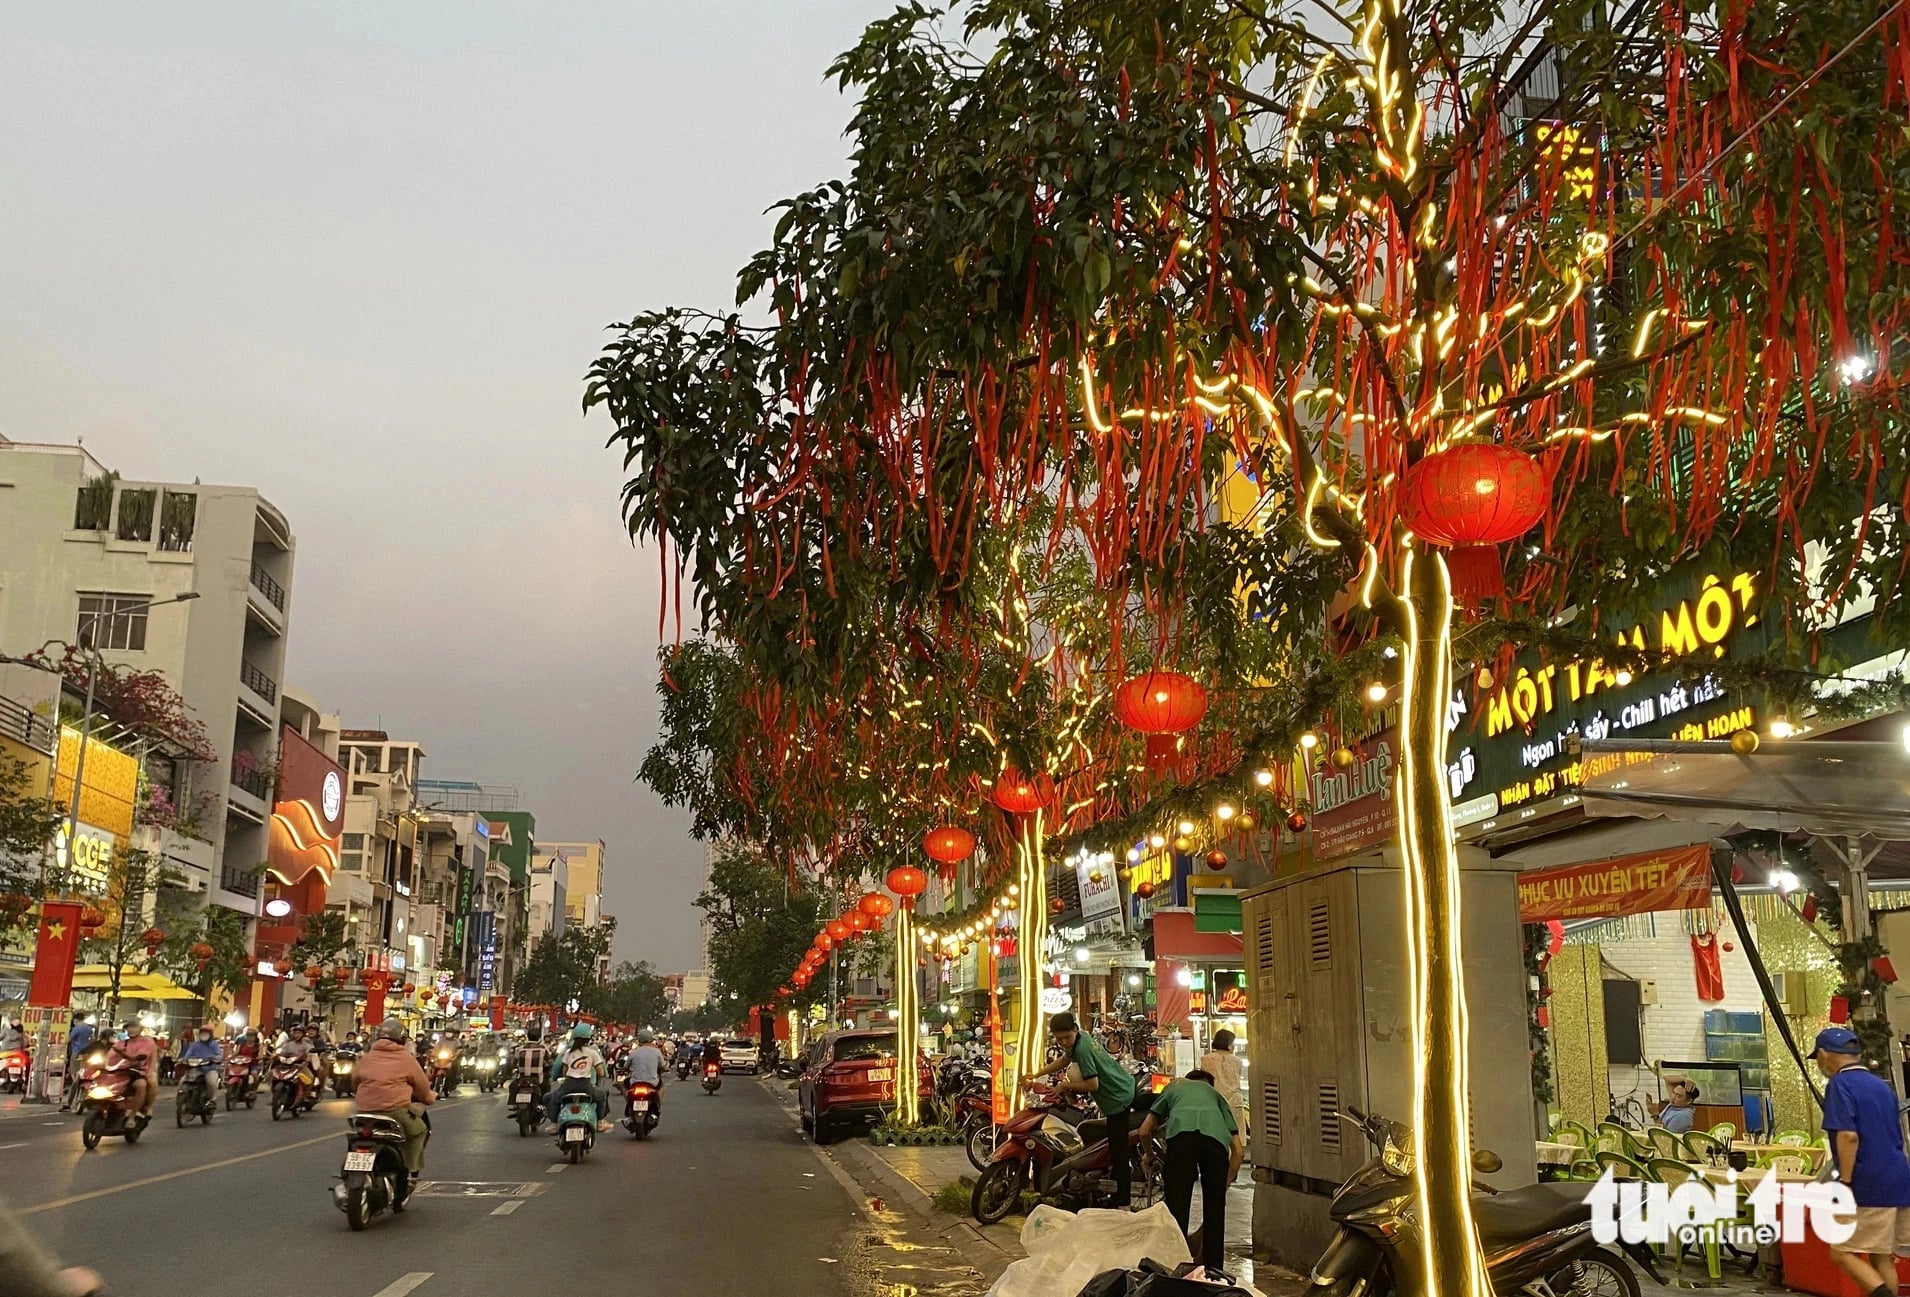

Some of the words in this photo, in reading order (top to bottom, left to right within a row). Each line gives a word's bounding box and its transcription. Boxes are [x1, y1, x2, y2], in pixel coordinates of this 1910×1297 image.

[1488, 667, 1556, 737] MỘT
[1522, 740, 1554, 768] Ngon
[1621, 698, 1655, 730] Chill
[1660, 680, 1689, 717] hết
[1501, 782, 1531, 807] NHẬN
[1534, 772, 1555, 798] ĐẶT
[1591, 753, 1621, 778] SINH
[1717, 707, 1753, 739] HOAN
[1554, 877, 1574, 903] VỤ
[1578, 865, 1632, 897] XUYÊN
[1635, 857, 1669, 889] TẾT
[52, 1010, 74, 1025] XE
